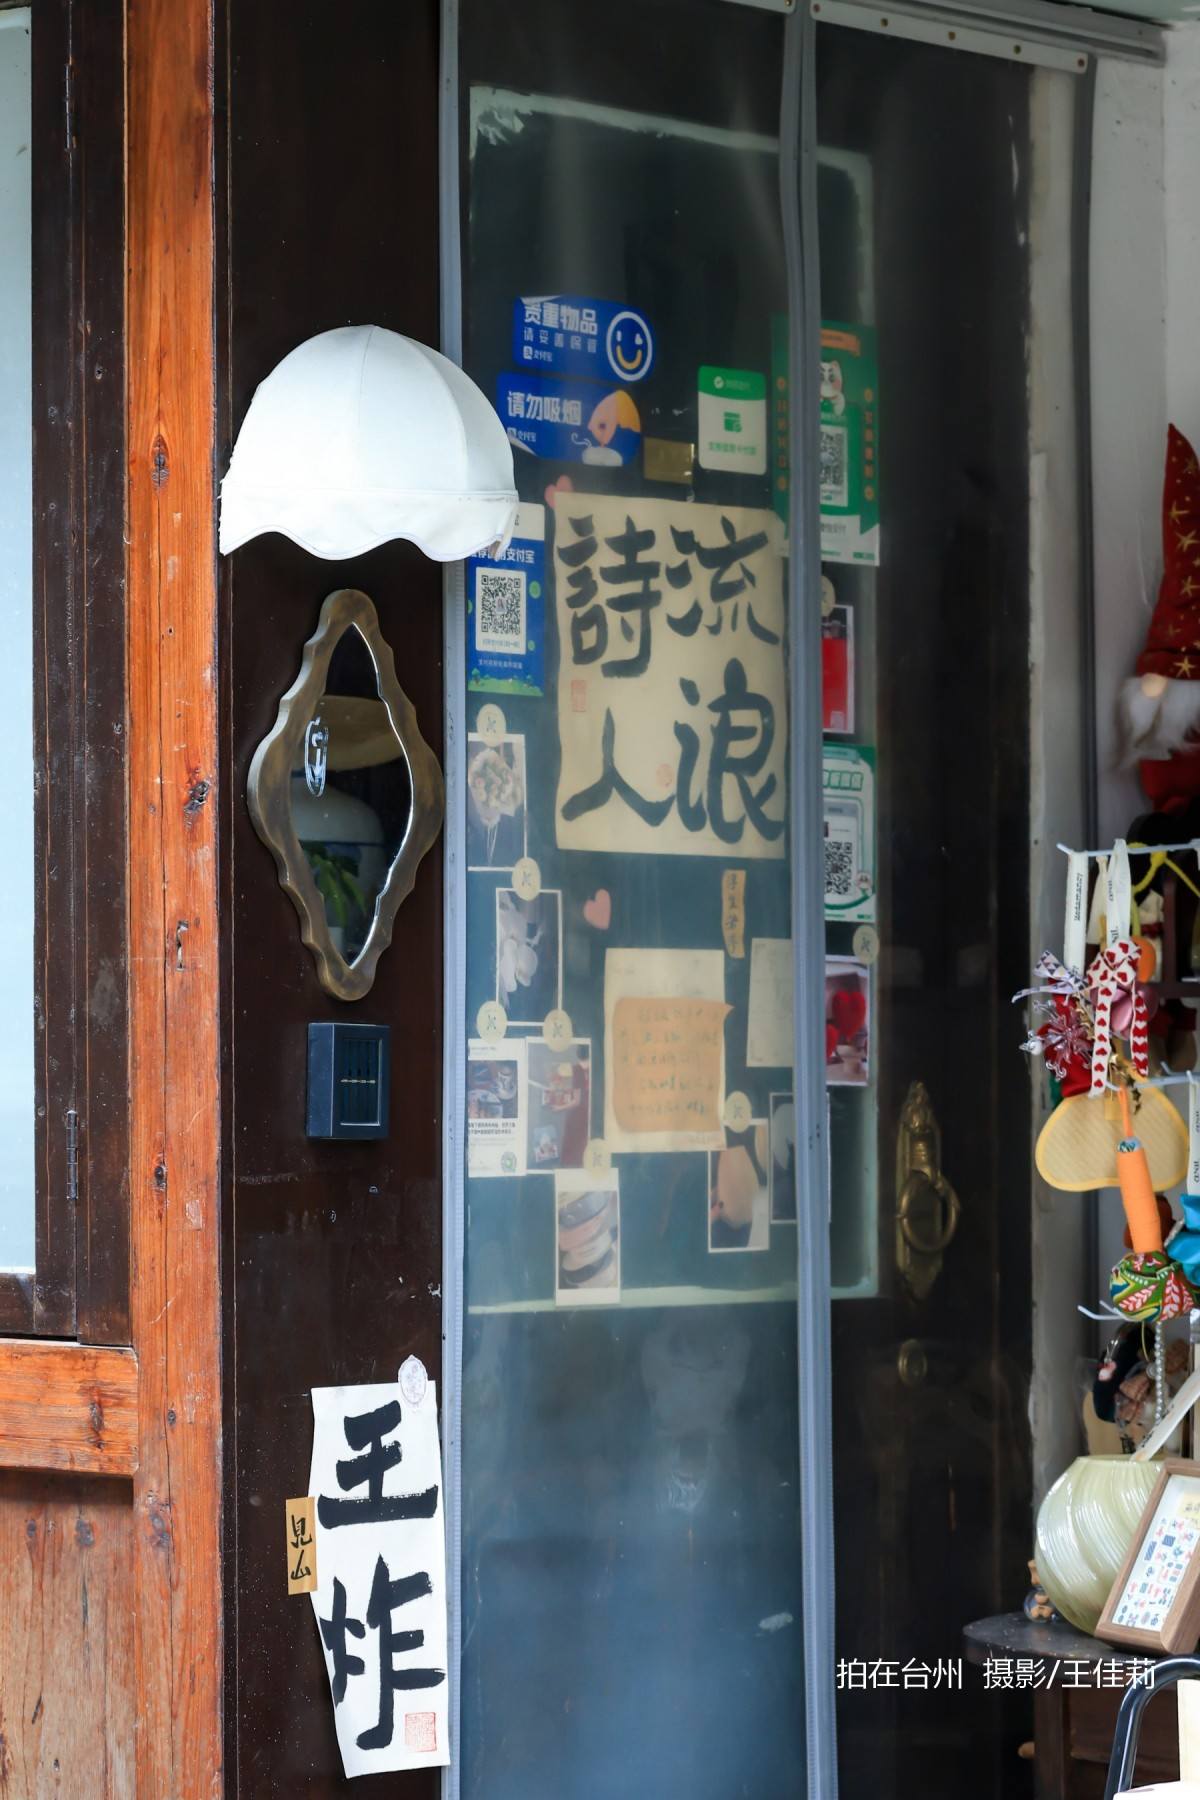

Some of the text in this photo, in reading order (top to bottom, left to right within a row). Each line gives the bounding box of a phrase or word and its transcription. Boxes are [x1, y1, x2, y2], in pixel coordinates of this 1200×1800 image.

[524, 302, 598, 336] 贵重物品
[507, 390, 582, 426] 请勿吸烟
[318, 1400, 446, 1751] 王炸
